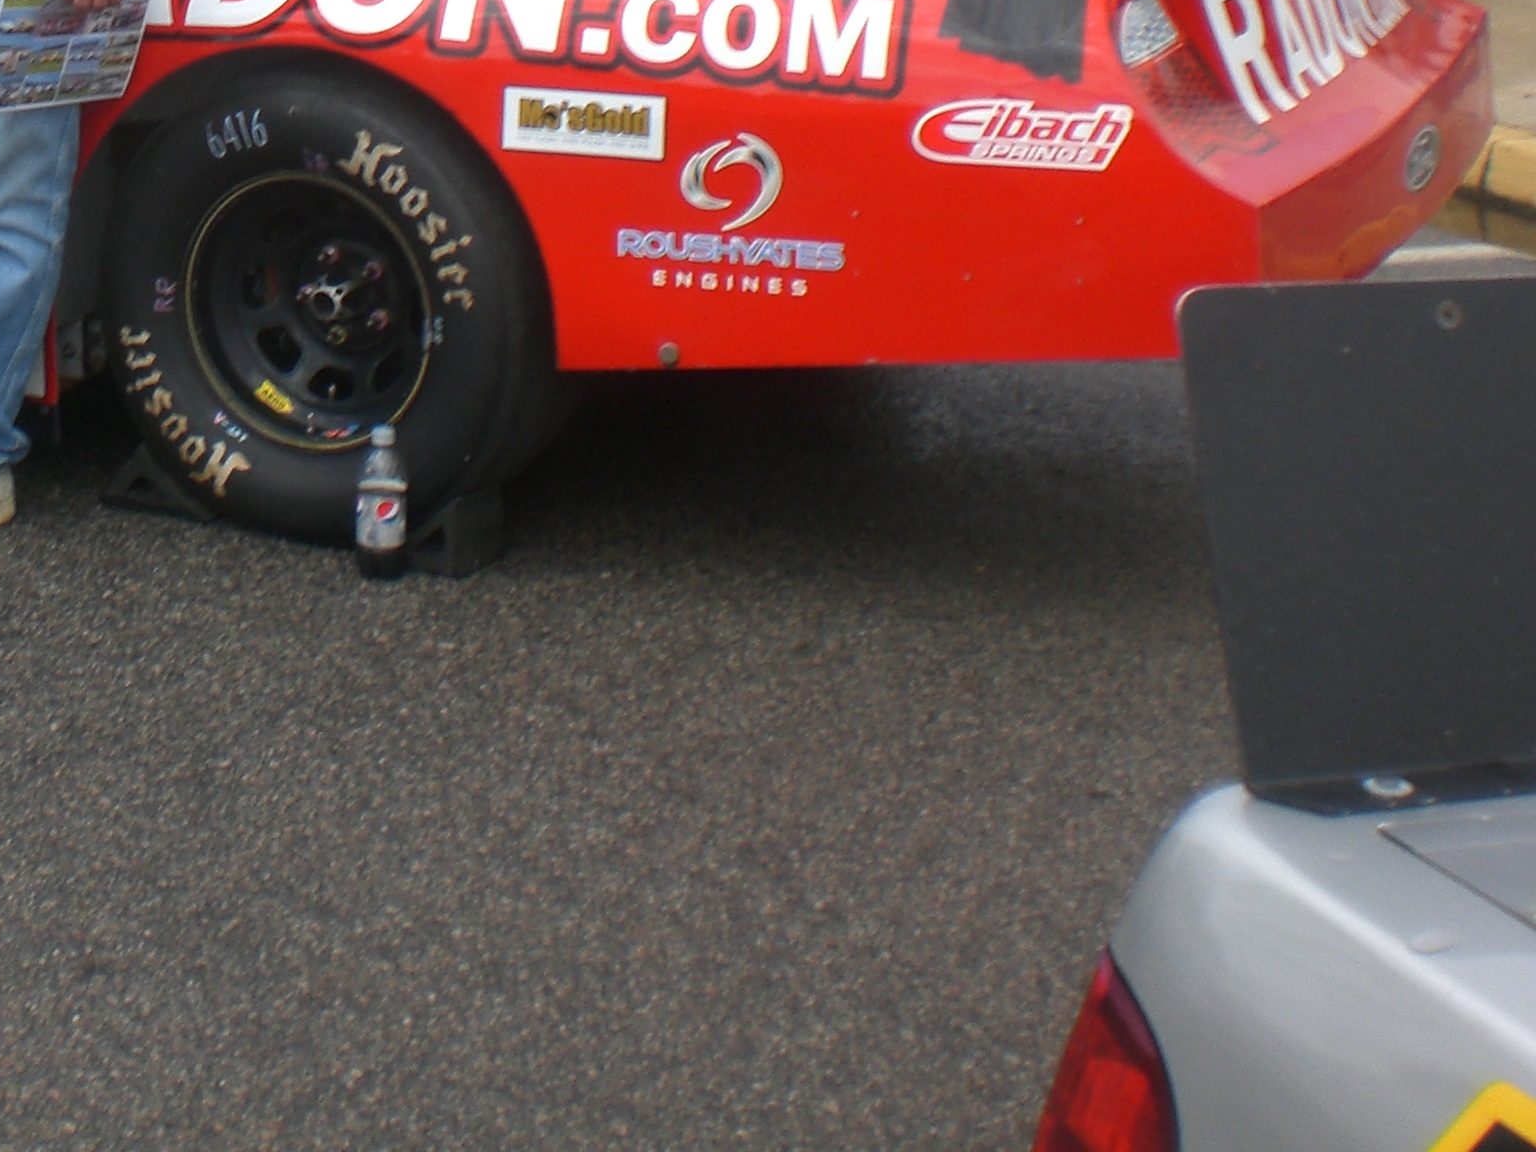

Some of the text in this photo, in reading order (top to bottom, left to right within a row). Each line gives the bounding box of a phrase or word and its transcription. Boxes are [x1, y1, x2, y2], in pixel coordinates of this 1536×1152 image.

[205, 107, 270, 159] 6416
[914, 99, 1130, 158] Eibach
[336, 129, 476, 311] Hoosier
[616, 227, 846, 272] ROUSHYATES
[651, 268, 809, 297] ENGINES
